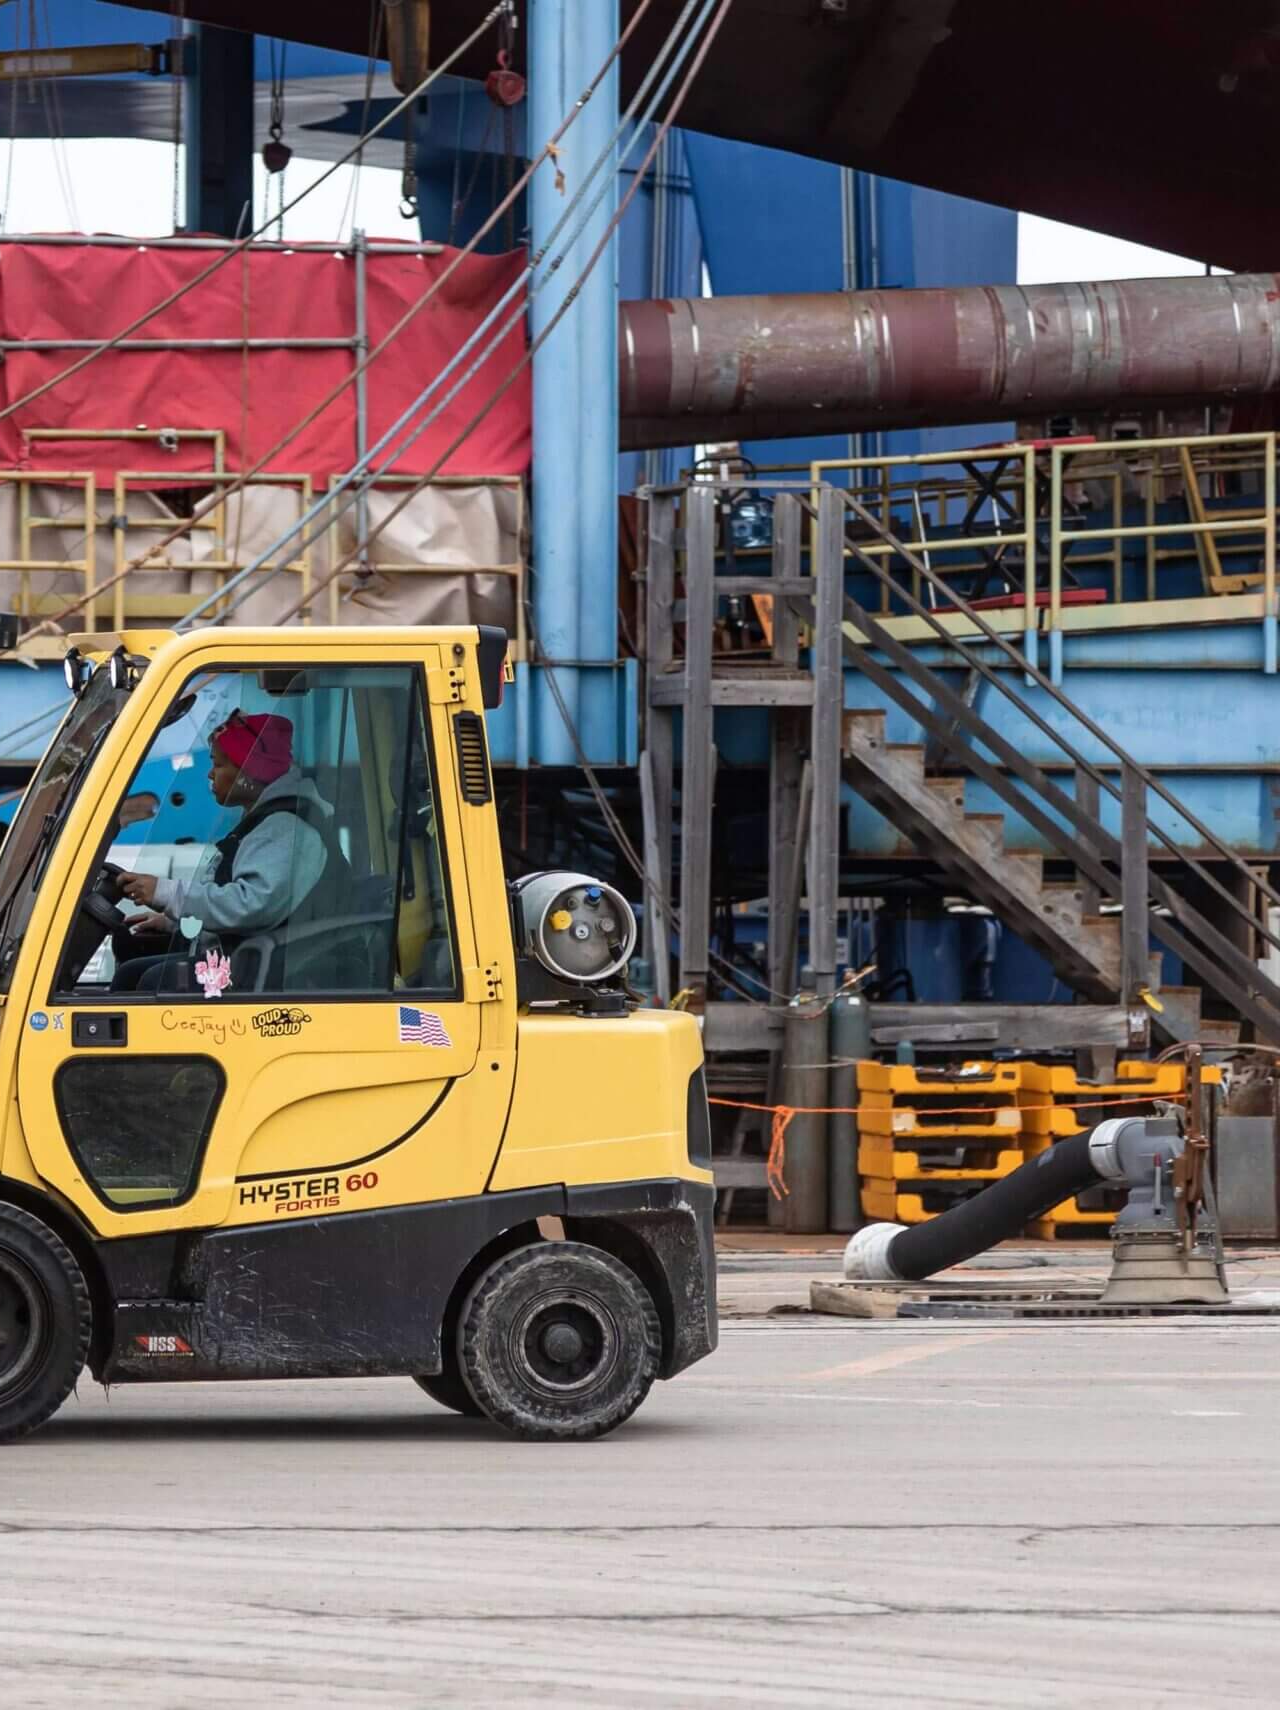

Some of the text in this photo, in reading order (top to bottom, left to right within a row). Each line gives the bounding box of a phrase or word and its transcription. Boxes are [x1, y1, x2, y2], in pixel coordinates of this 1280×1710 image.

[252, 1008, 281, 1029] LOUD
[261, 1023, 301, 1037] PROUD
[240, 1171, 379, 1205] HYSTER 60
[275, 1196, 340, 1213] FORTIS
